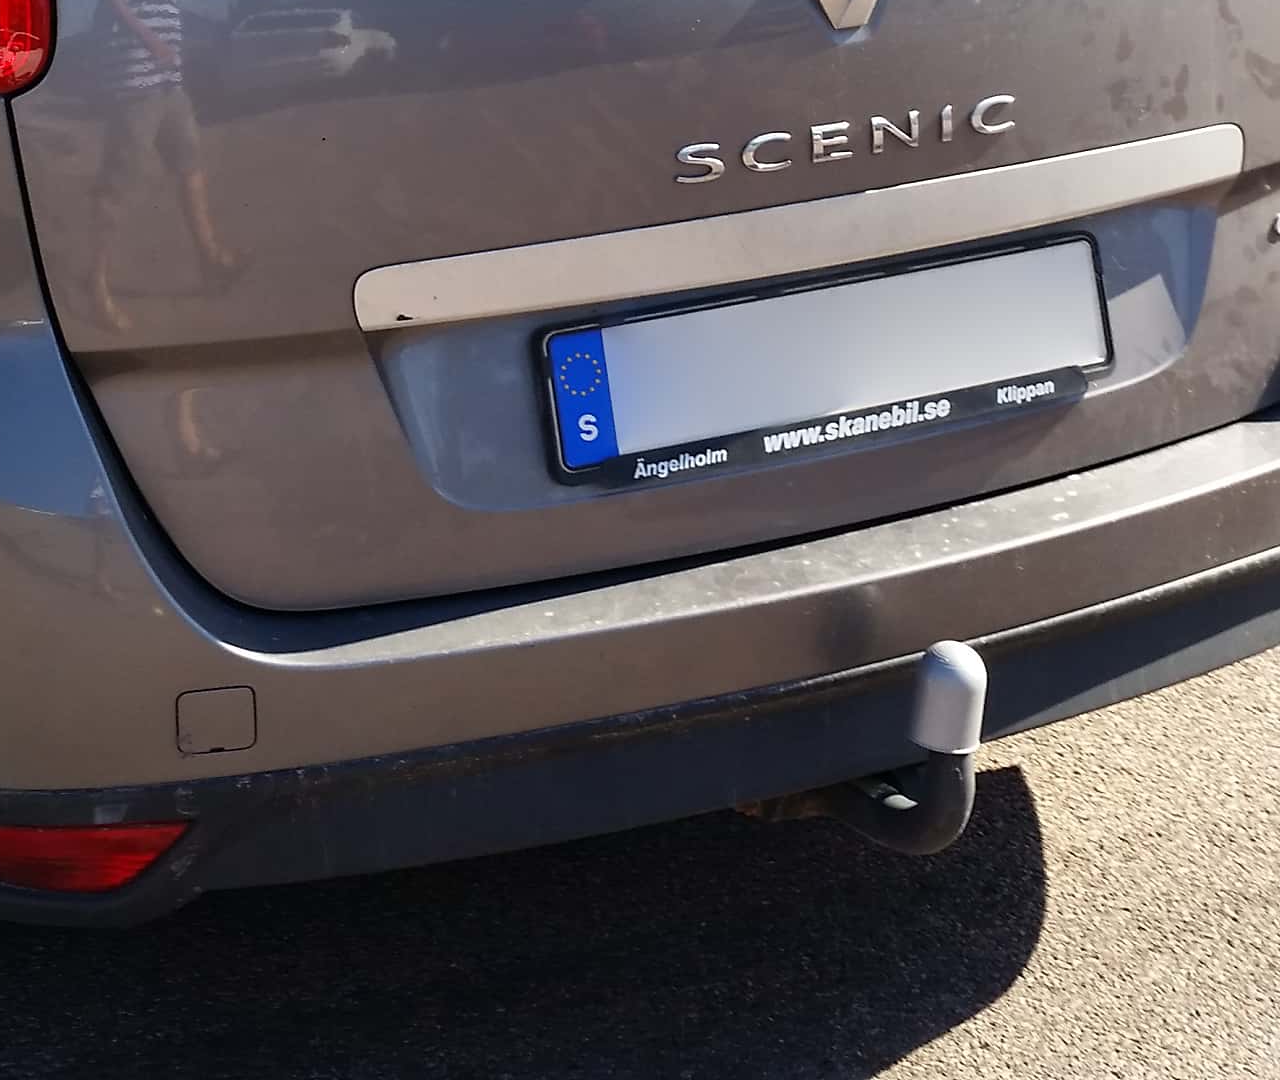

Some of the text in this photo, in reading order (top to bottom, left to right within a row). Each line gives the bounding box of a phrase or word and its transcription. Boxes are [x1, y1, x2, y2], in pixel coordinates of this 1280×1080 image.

[675, 93, 1017, 186] SCENIC
[577, 413, 600, 443] S
[633, 379, 1055, 480] Ängelholm www.skanebil.se Klippan
